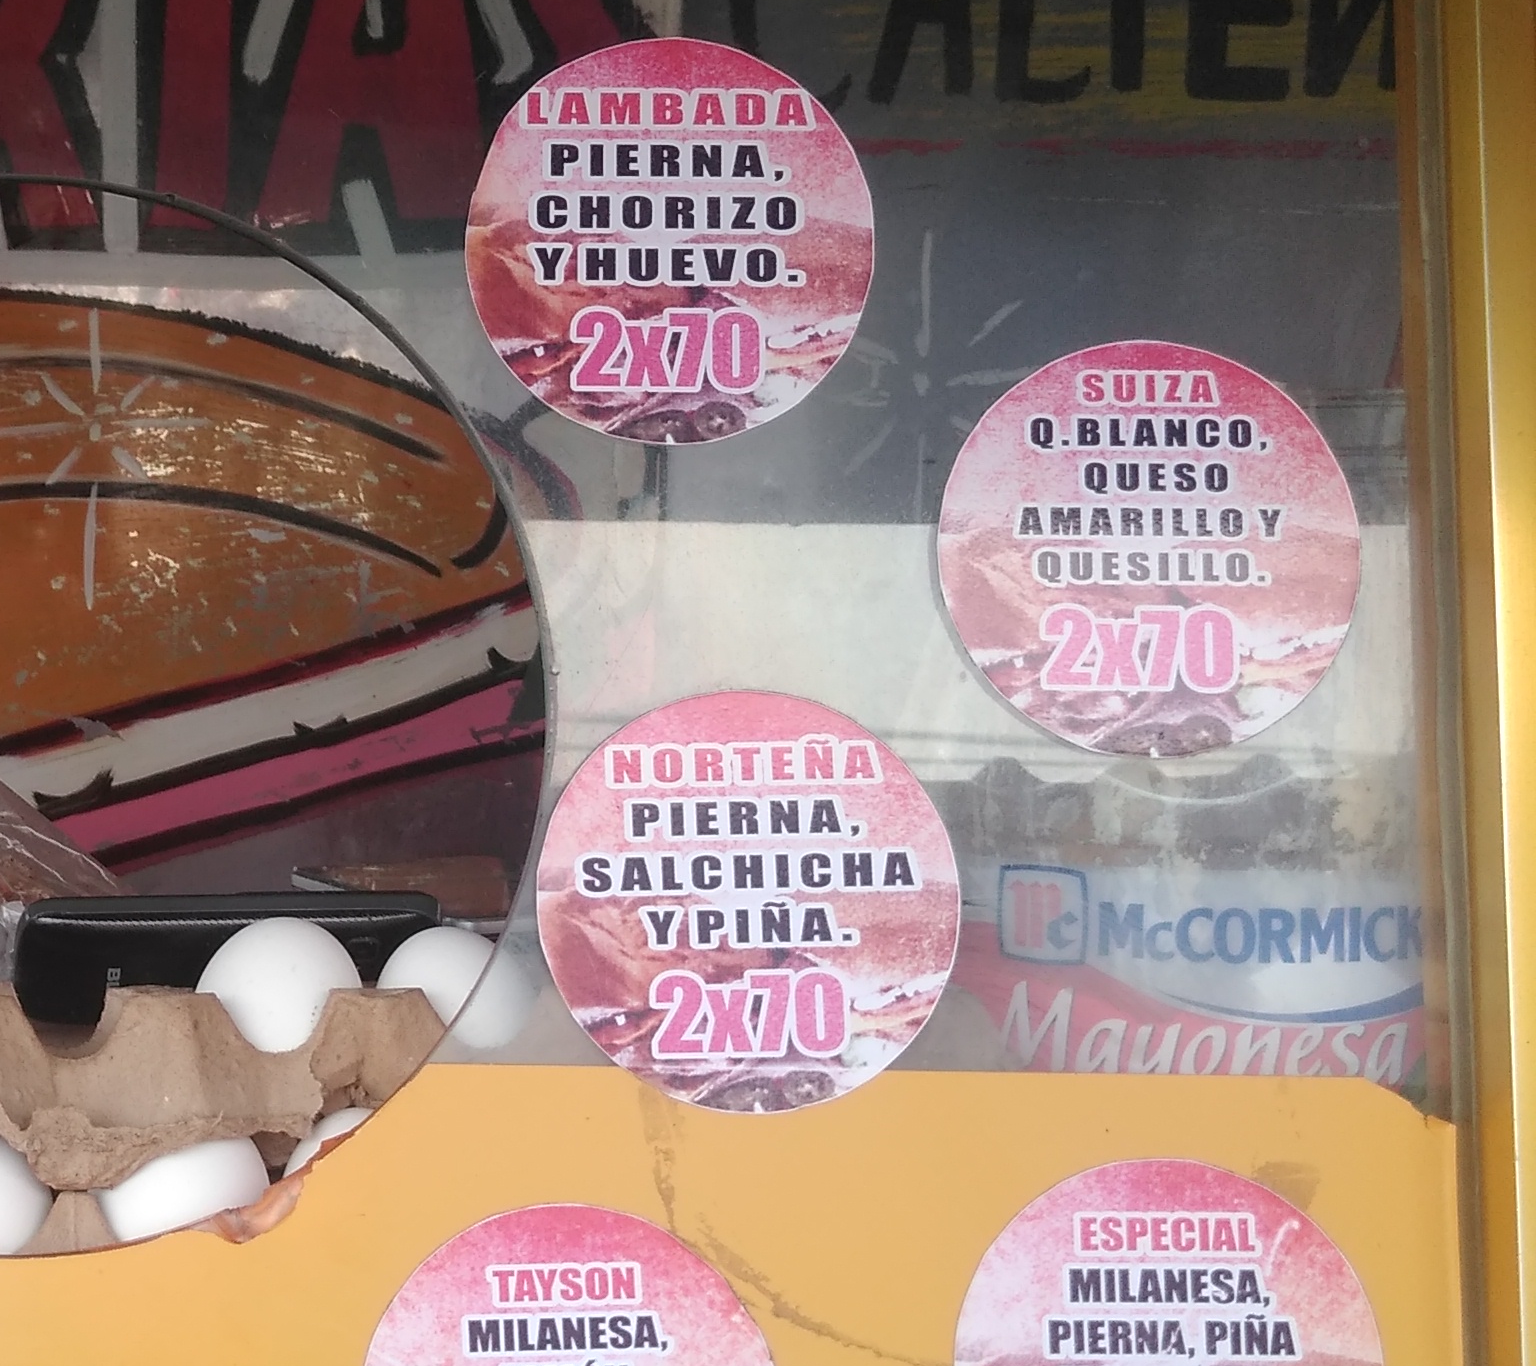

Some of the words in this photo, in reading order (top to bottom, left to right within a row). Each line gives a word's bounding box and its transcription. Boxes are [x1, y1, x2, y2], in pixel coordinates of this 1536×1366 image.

[524, 89, 810, 128] LAMBADA
[547, 142, 787, 183] PIERNA,
[533, 194, 799, 232] CHORIZO
[531, 245, 568, 283] Y
[583, 246, 801, 284] HUEVO.
[573, 308, 763, 391] 2x70
[1079, 372, 1216, 405] SUIZA
[1027, 415, 1270, 453] Q.BLANCO,
[1082, 460, 1230, 495] QUESO
[1016, 505, 1245, 539] AMARILLO
[1257, 507, 1284, 538] Y
[1035, 549, 1268, 585] QUESILLO.
[1042, 606, 1237, 691] 2x70
[610, 736, 877, 785] NORTEÑA
[629, 797, 863, 839] PIERNA,
[580, 849, 917, 894] SALCHICHA
[644, 909, 679, 947] Y
[695, 900, 855, 945] PIÑA.
[1096, 900, 1424, 965] McCORMICK
[653, 973, 848, 1055] 2x70
[999, 979, 1410, 1086] Mayonesa
[1077, 1215, 1257, 1254] ESPECIAL
[490, 1265, 638, 1305] TAYSON
[1066, 1266, 1273, 1309] MILANESA,
[466, 1313, 670, 1355] MILANESA,
[1046, 1318, 1198, 1361] PIERNA,
[1203, 1312, 1298, 1358] PIÑA
